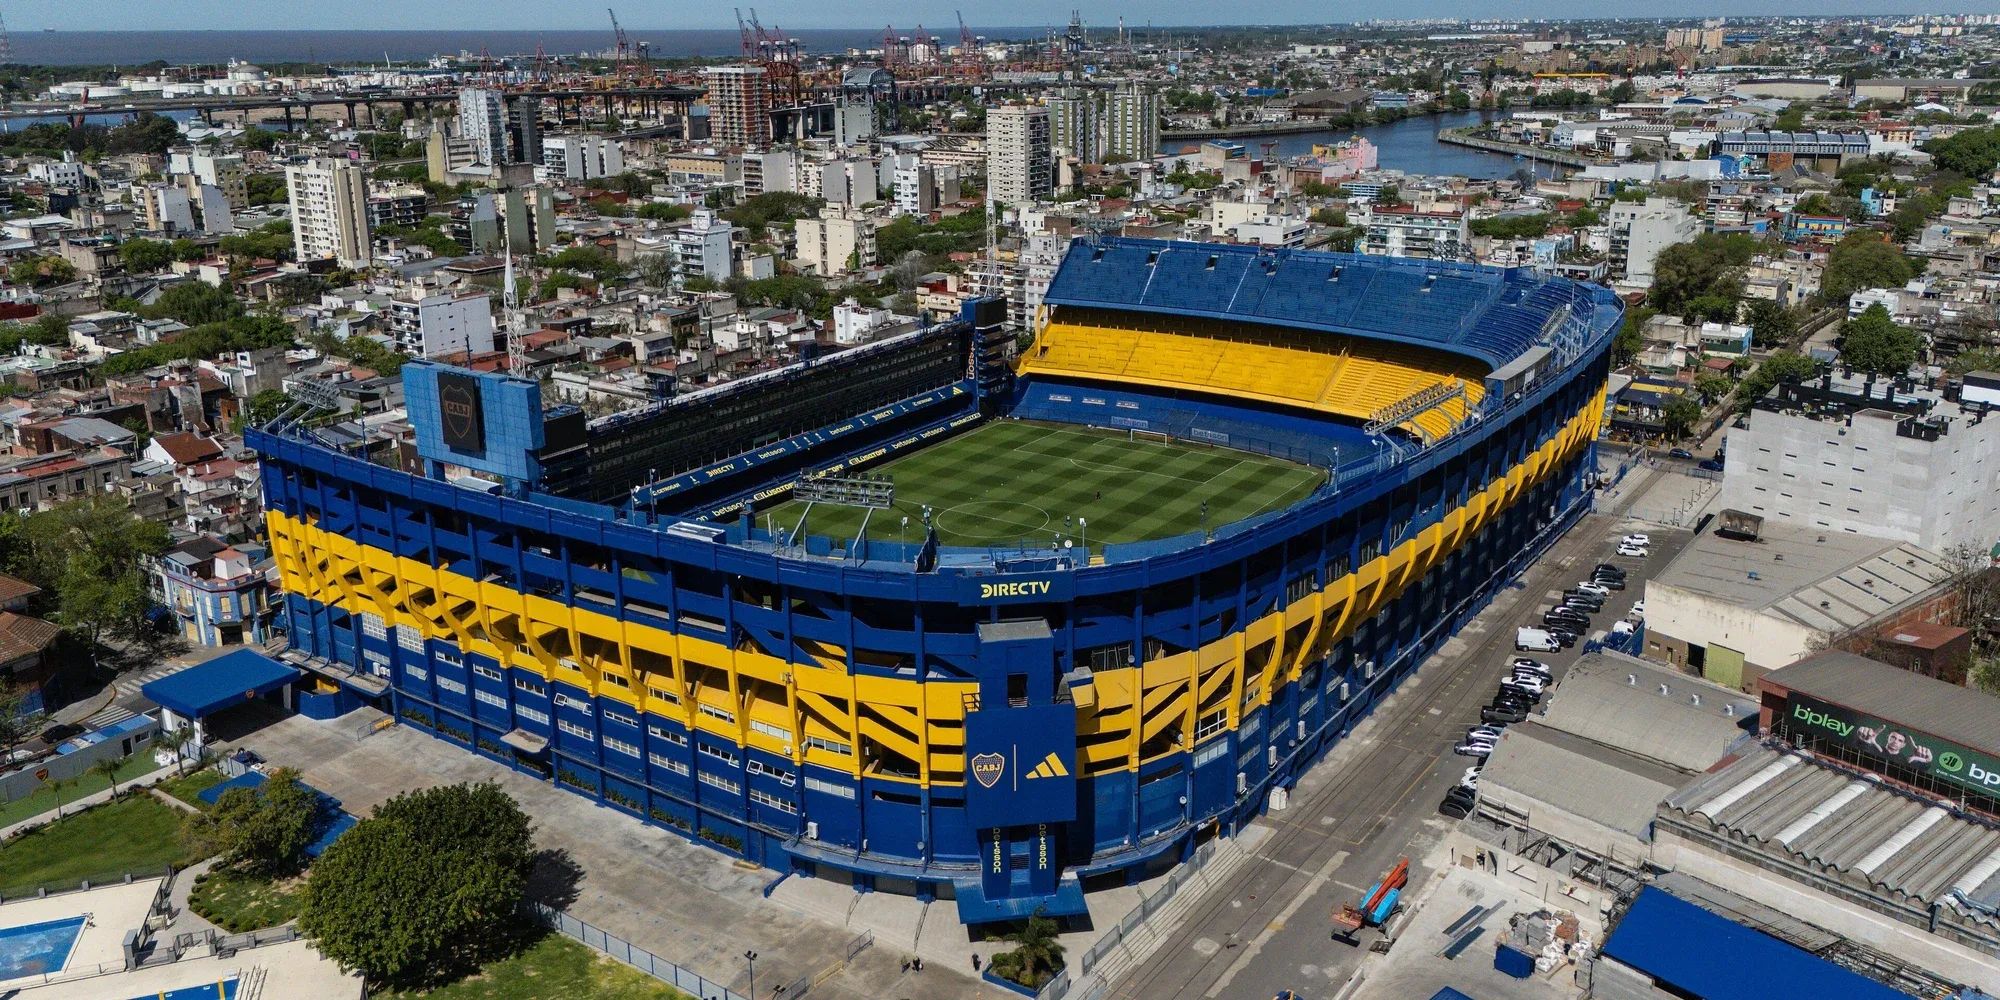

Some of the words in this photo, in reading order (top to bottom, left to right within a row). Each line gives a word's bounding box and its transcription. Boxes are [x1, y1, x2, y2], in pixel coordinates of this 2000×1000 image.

[829, 423, 855, 436] betsson
[920, 426, 946, 439] betsson
[891, 436, 919, 449] betsson
[758, 446, 787, 460] betsson
[705, 463, 735, 478] DIRECTV
[981, 581, 1051, 598] DIRECTV
[1793, 704, 1855, 737] bplay
[976, 764, 1001, 772] CABJ
[1942, 756, 1958, 768] +18
[993, 827, 1002, 874] betsson
[1039, 823, 1047, 870] betsson
